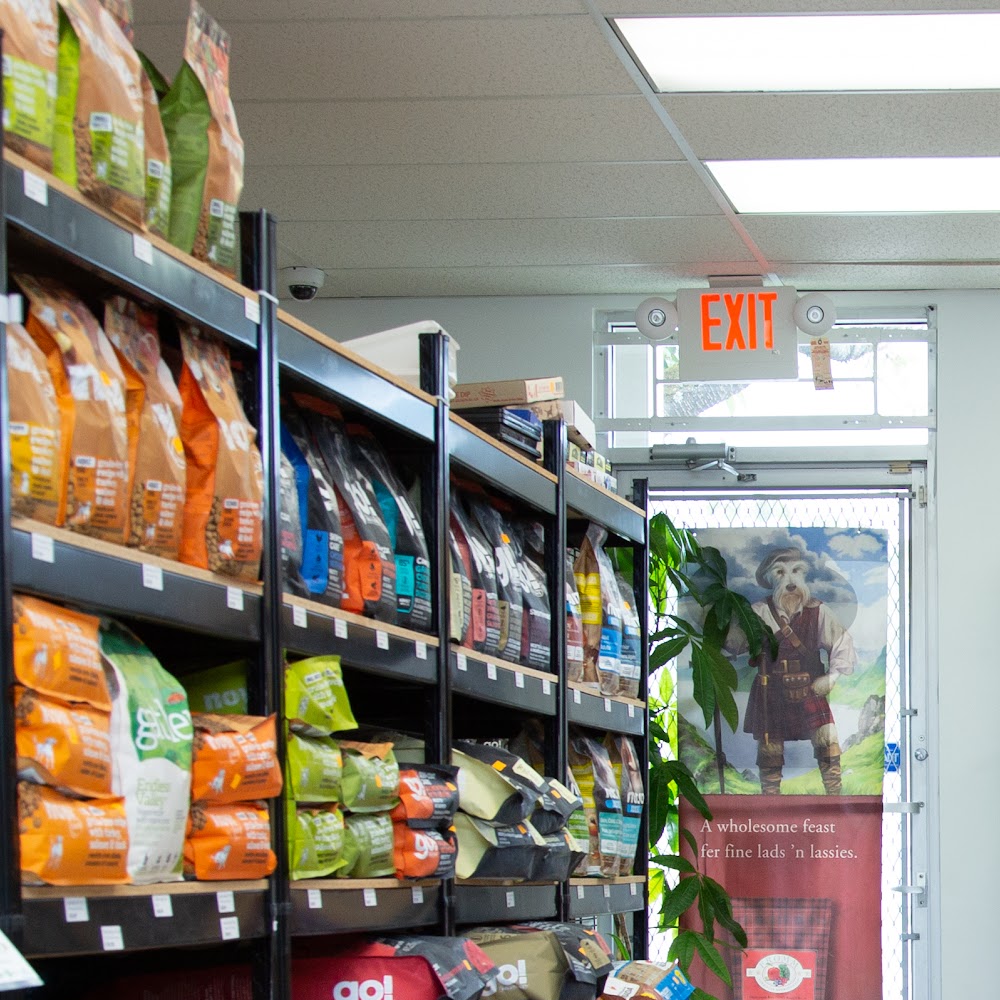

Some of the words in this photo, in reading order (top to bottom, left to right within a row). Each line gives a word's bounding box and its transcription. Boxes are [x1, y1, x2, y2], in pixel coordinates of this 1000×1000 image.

[701, 292, 778, 351] EXIT
[700, 819, 712, 833] A
[717, 819, 798, 833] wholesome
[802, 819, 836, 833] feast
[700, 844, 720, 859] fer
[725, 844, 753, 859] fine
[757, 844, 786, 859] lads
[790, 844, 805, 859] 'n
[809, 844, 858, 859] lassies.
